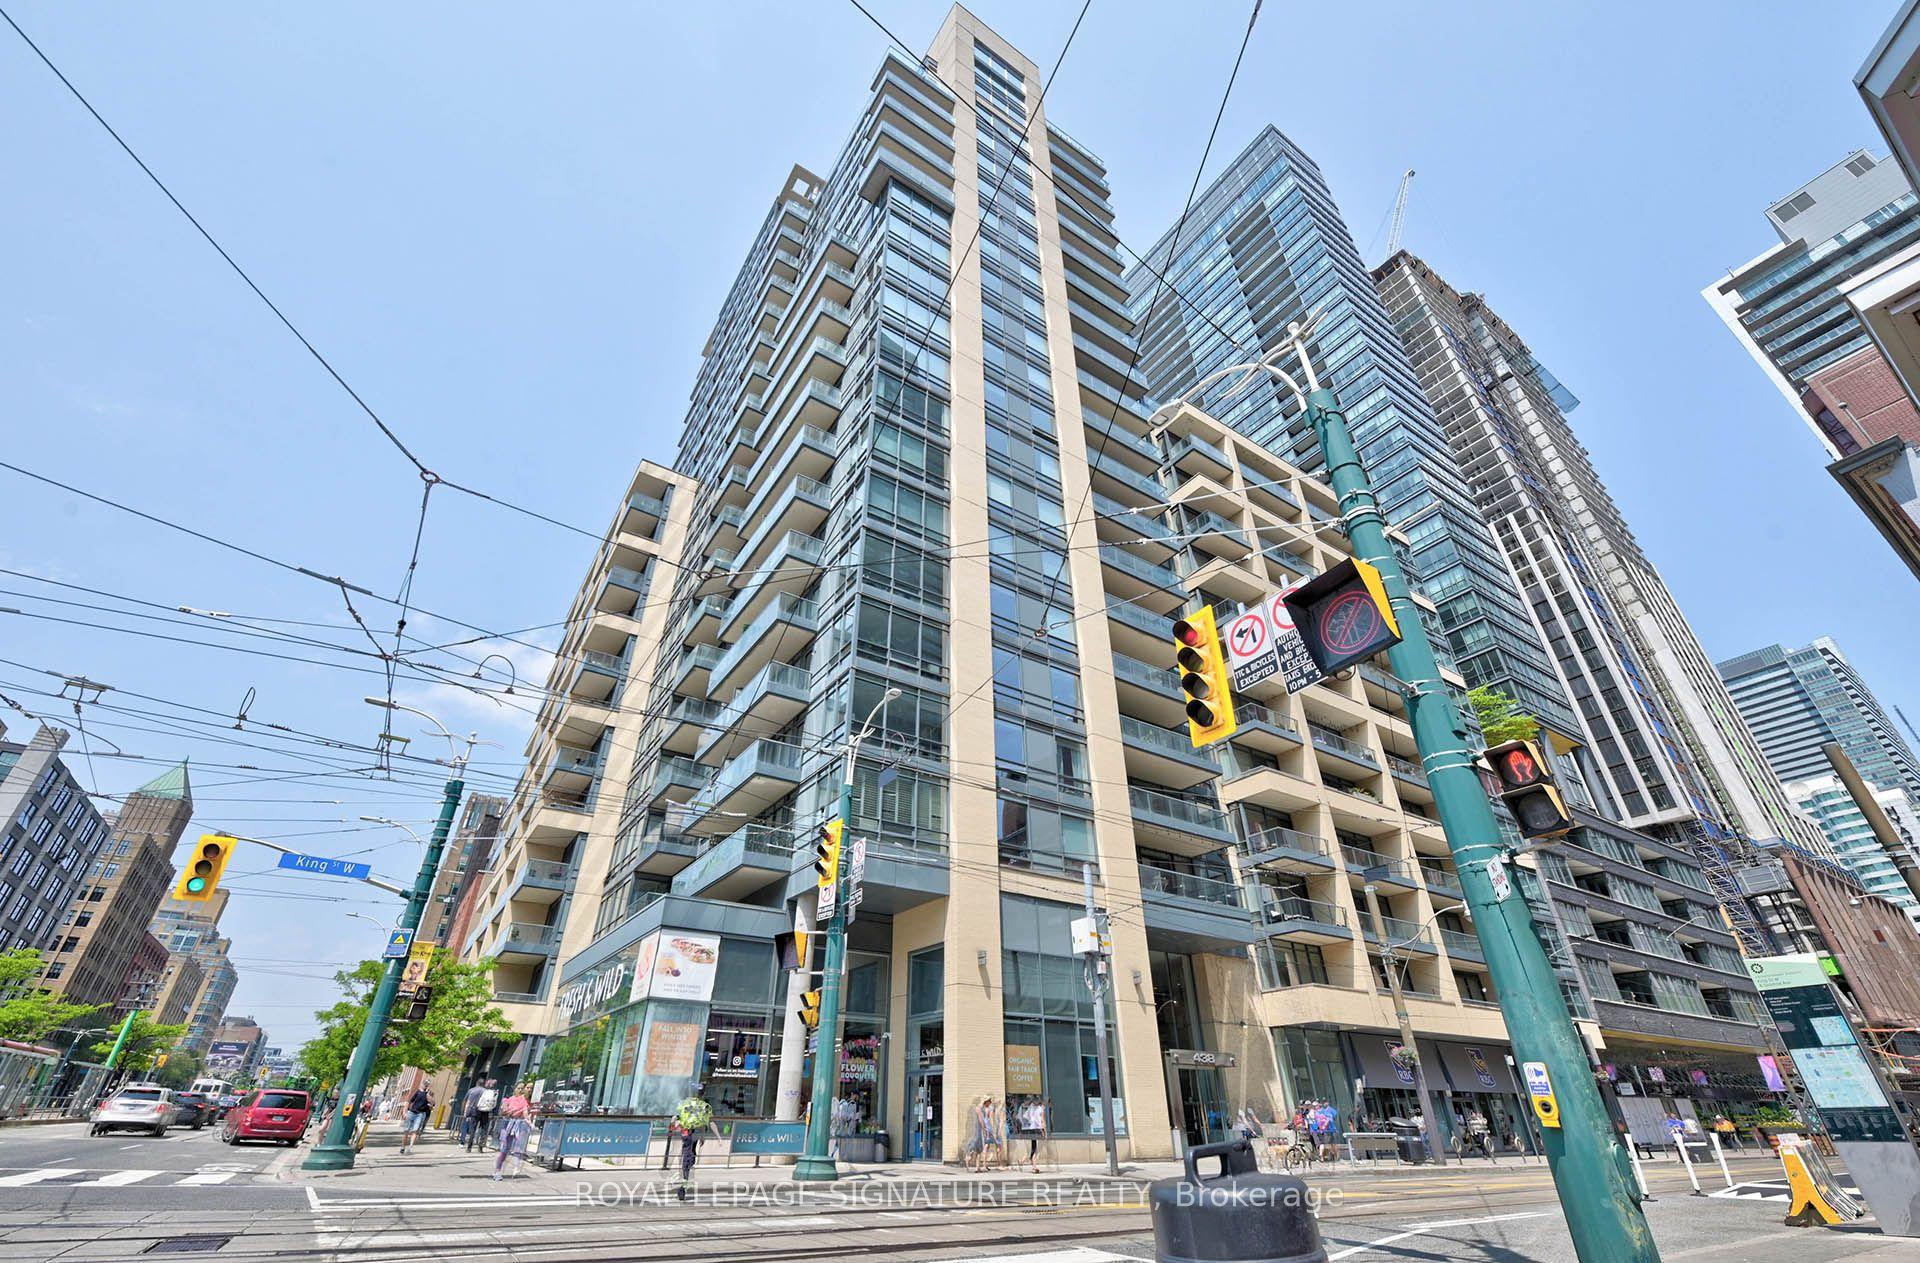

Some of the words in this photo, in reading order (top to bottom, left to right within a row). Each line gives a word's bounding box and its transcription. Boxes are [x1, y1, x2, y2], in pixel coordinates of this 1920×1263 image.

[1251, 653, 1276, 670] BICYCLES
[1280, 651, 1293, 664] AND
[1295, 644, 1307, 655] BIC
[1286, 652, 1309, 669] EXCEP
[1240, 665, 1275, 687] EXCEPTED
[1284, 669, 1301, 682] TAXIS
[295, 856, 328, 872] King
[343, 863, 356, 874] W
[593, 963, 624, 1006] WILD
[1194, 1053, 1215, 1063] 438
[841, 1064, 875, 1073] FLOWER
[1398, 1070, 1414, 1080] RBC
[841, 1072, 876, 1081] BOUQUETS
[1480, 1075, 1494, 1084] RBC
